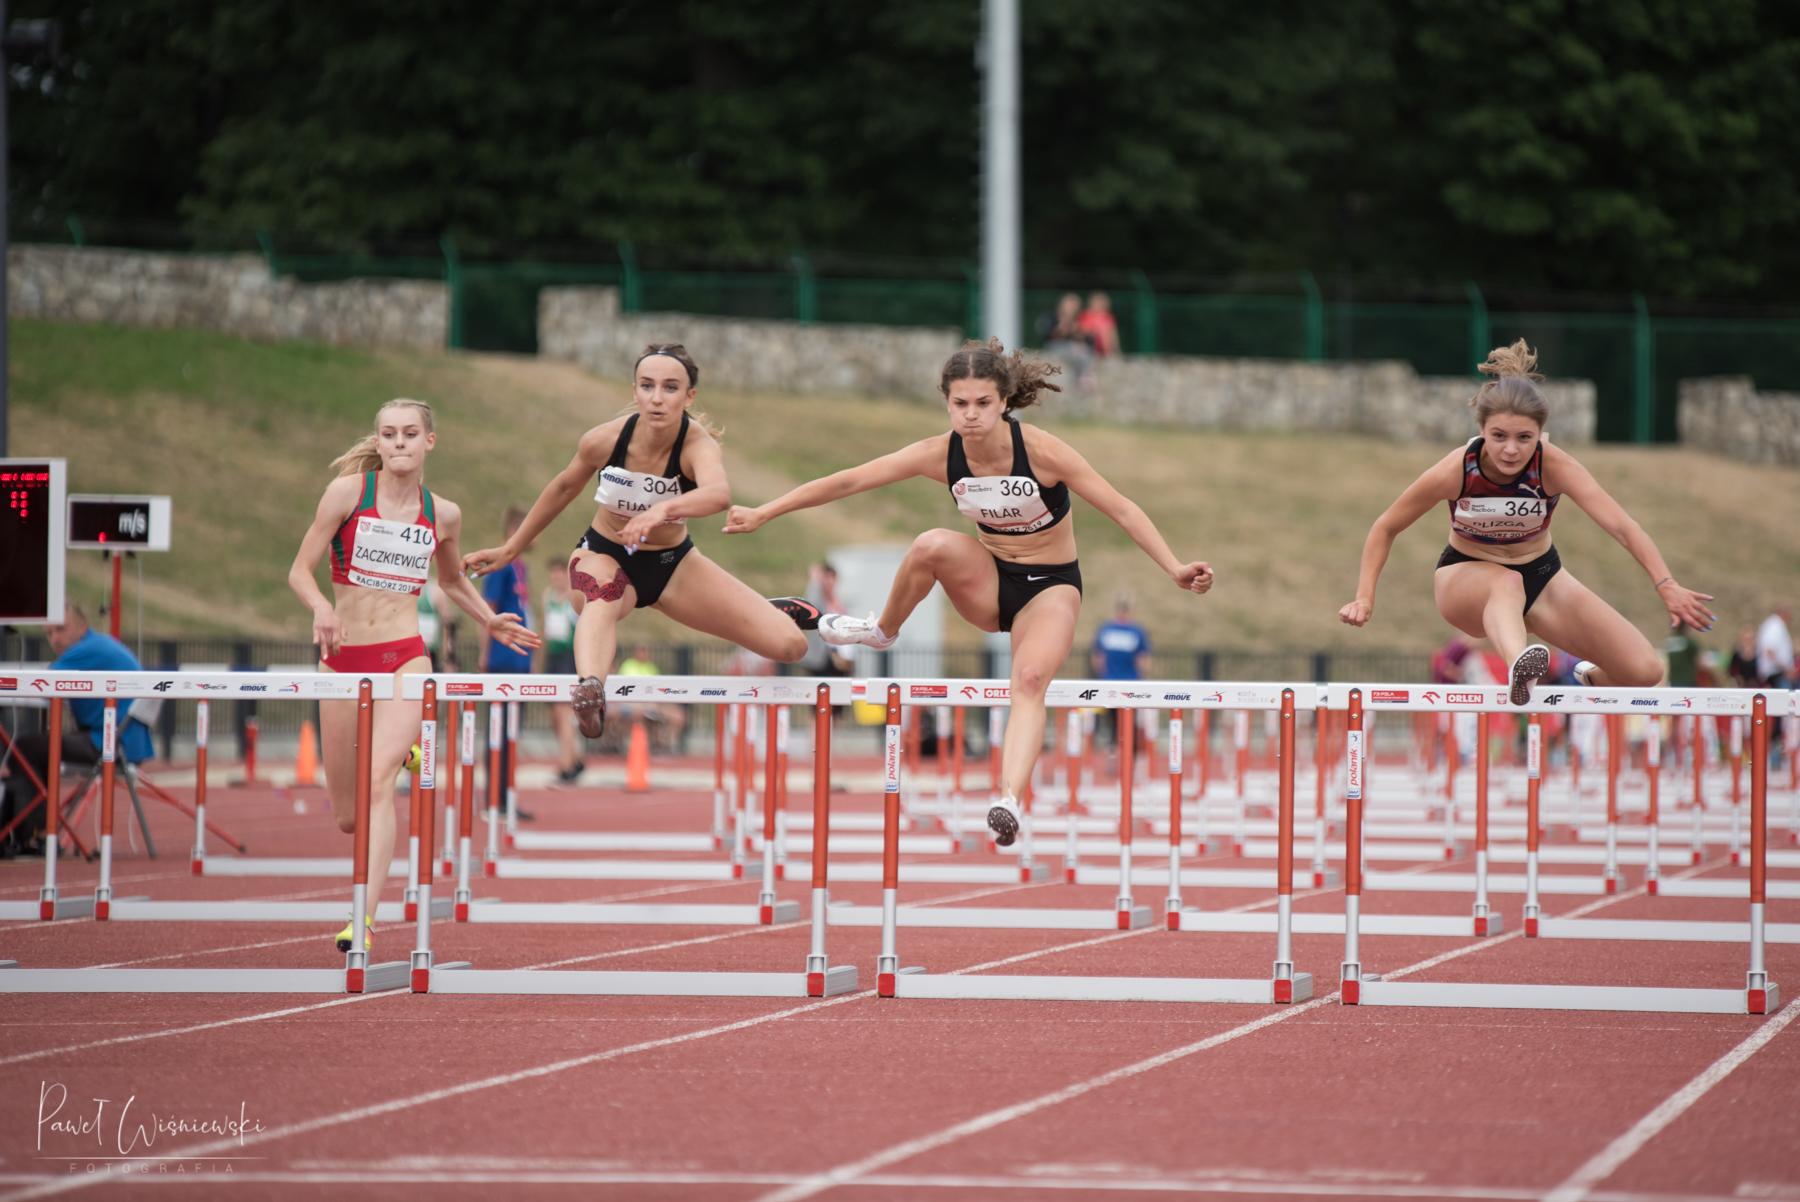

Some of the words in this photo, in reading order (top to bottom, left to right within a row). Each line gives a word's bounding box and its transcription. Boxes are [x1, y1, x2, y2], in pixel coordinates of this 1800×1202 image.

[602, 472, 634, 487] 4MOVE
[643, 477, 679, 495] 304
[1000, 480, 1034, 496] 360
[980, 508, 1022, 518] FILAR
[1504, 501, 1542, 516] 364
[119, 508, 147, 538] m/s
[400, 527, 432, 546] 410
[355, 545, 428, 570] ZACZKIEWICZ
[356, 575, 397, 591] RACIBÓRZ
[56, 682, 92, 690] ORLEN
[152, 681, 174, 692] 4F
[521, 686, 555, 695] ORLEN
[615, 685, 636, 696] 4F
[985, 689, 1011, 697] ORLE
[1078, 689, 1099, 700] 4F
[1448, 694, 1482, 703] ORLEN
[1543, 694, 1564, 705] 4F
[423, 738, 431, 776] polanik
[887, 743, 896, 780] polanik
[1349, 748, 1359, 786] polanik
